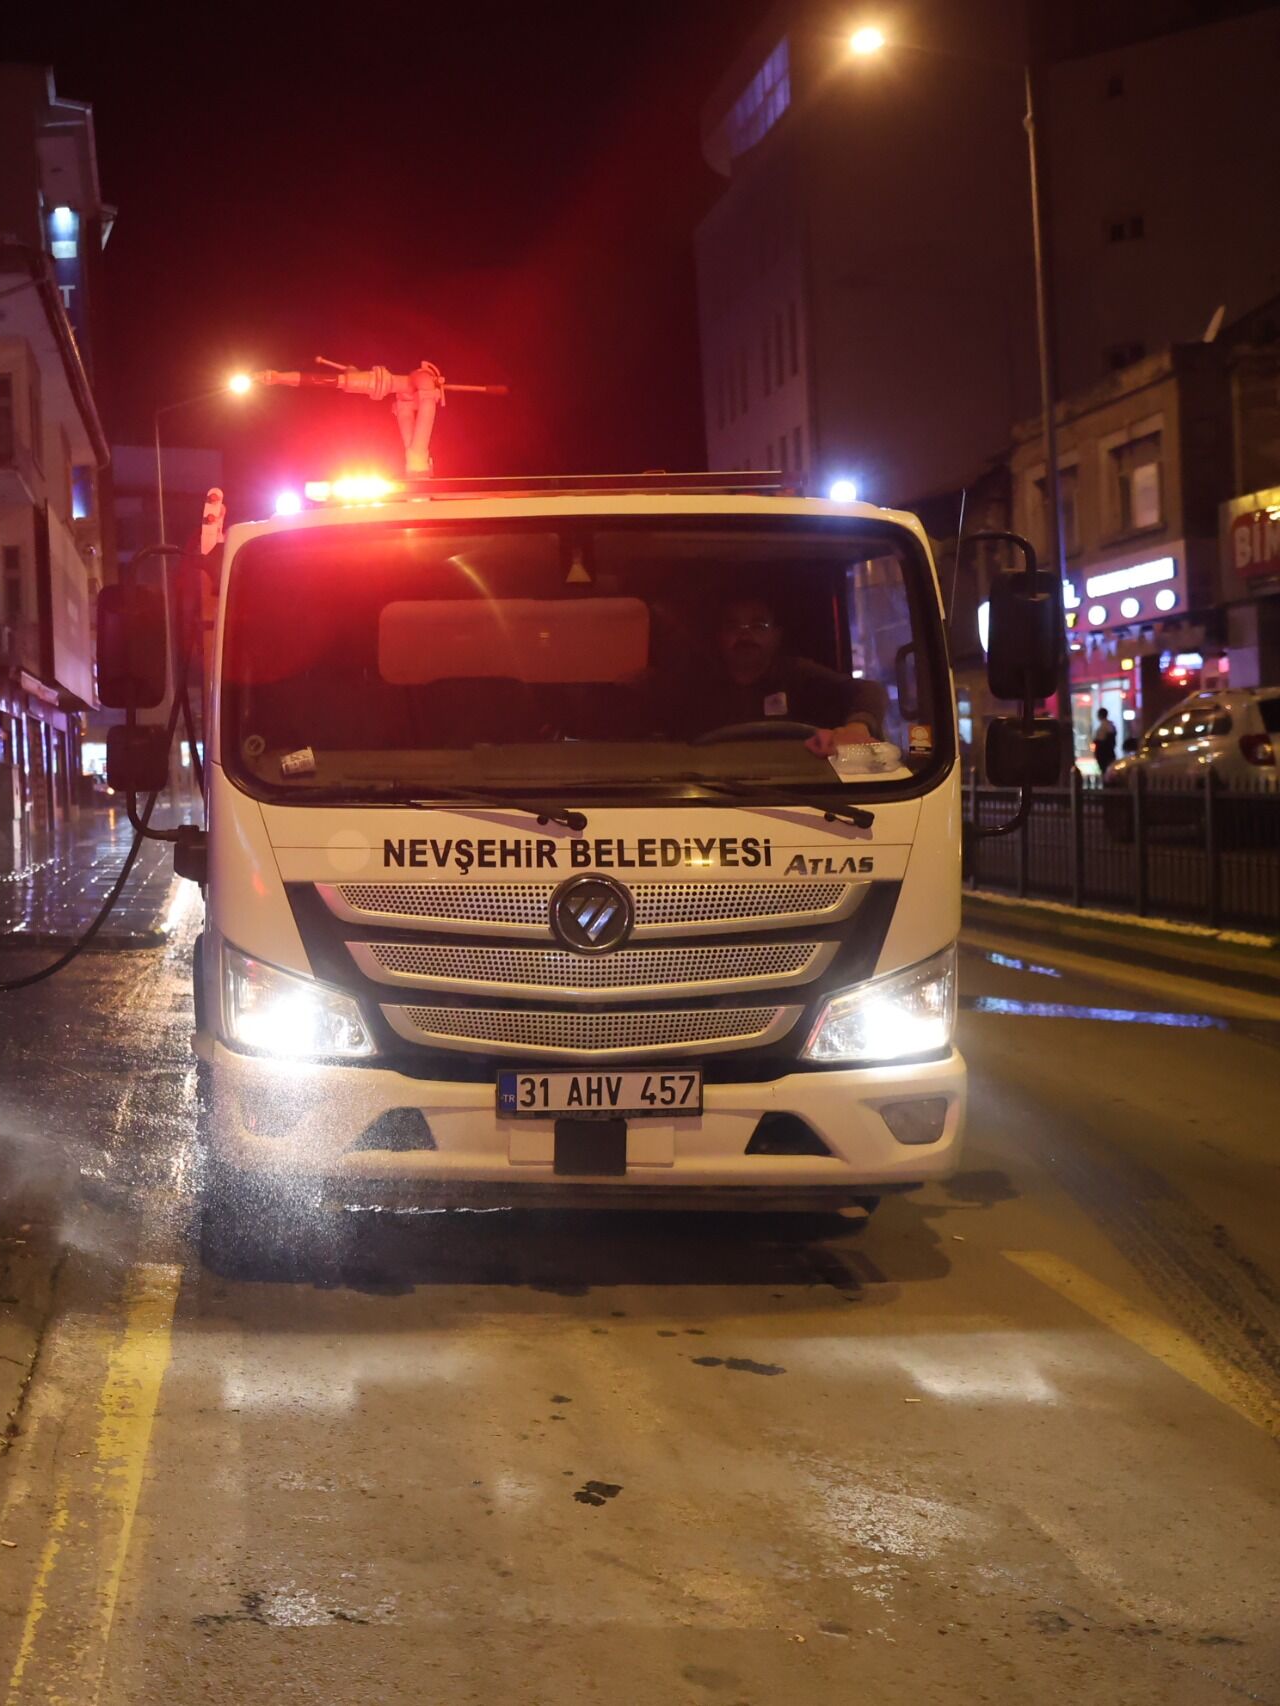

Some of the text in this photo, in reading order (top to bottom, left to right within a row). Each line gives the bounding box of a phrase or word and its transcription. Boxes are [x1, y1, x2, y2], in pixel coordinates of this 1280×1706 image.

[384, 837, 772, 875] NEVŞEHİR BELEDİYESİ
[784, 854, 874, 876] ATLAS
[503, 1094, 515, 1103] TR
[520, 1075, 696, 1107] 31 AHV 457
